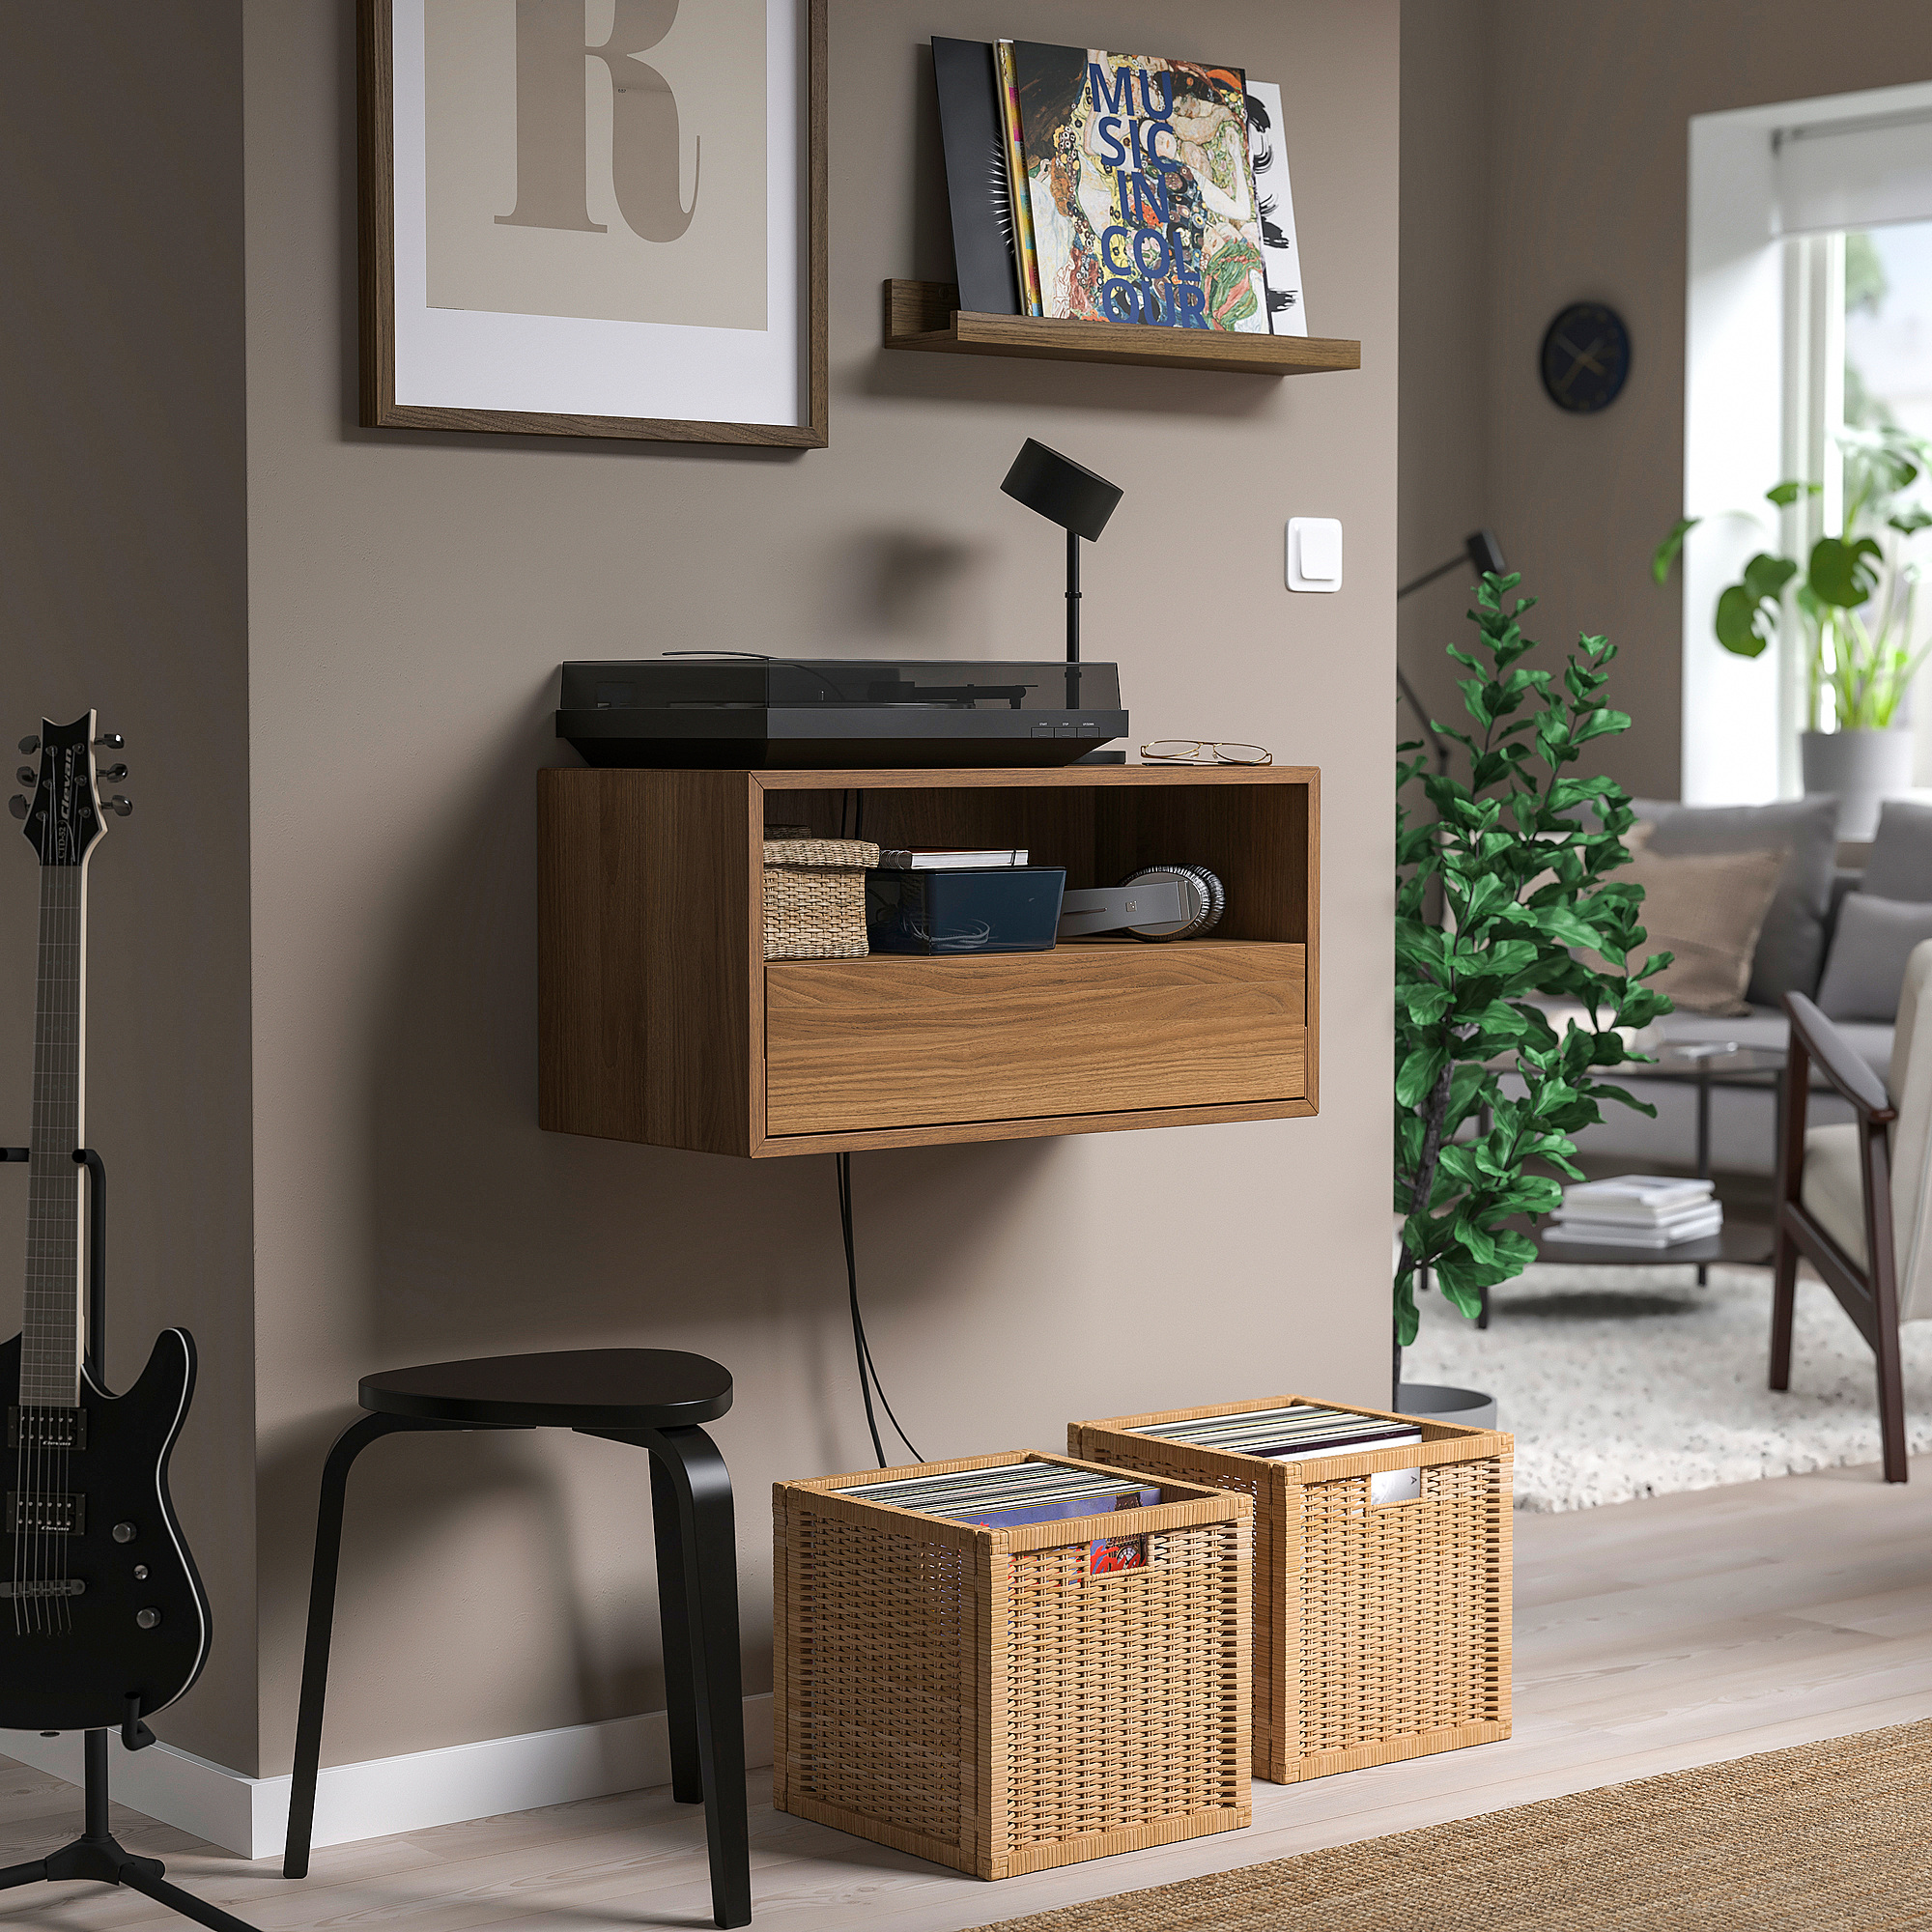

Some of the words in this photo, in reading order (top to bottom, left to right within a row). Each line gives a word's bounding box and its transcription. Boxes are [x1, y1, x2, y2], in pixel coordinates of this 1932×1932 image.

[1089, 63, 1174, 120] MU
[1098, 117, 1178, 172] SIC
[1117, 170, 1170, 223] IN
[1101, 225, 1201, 282] COL
[1102, 278, 1210, 329] OUR
